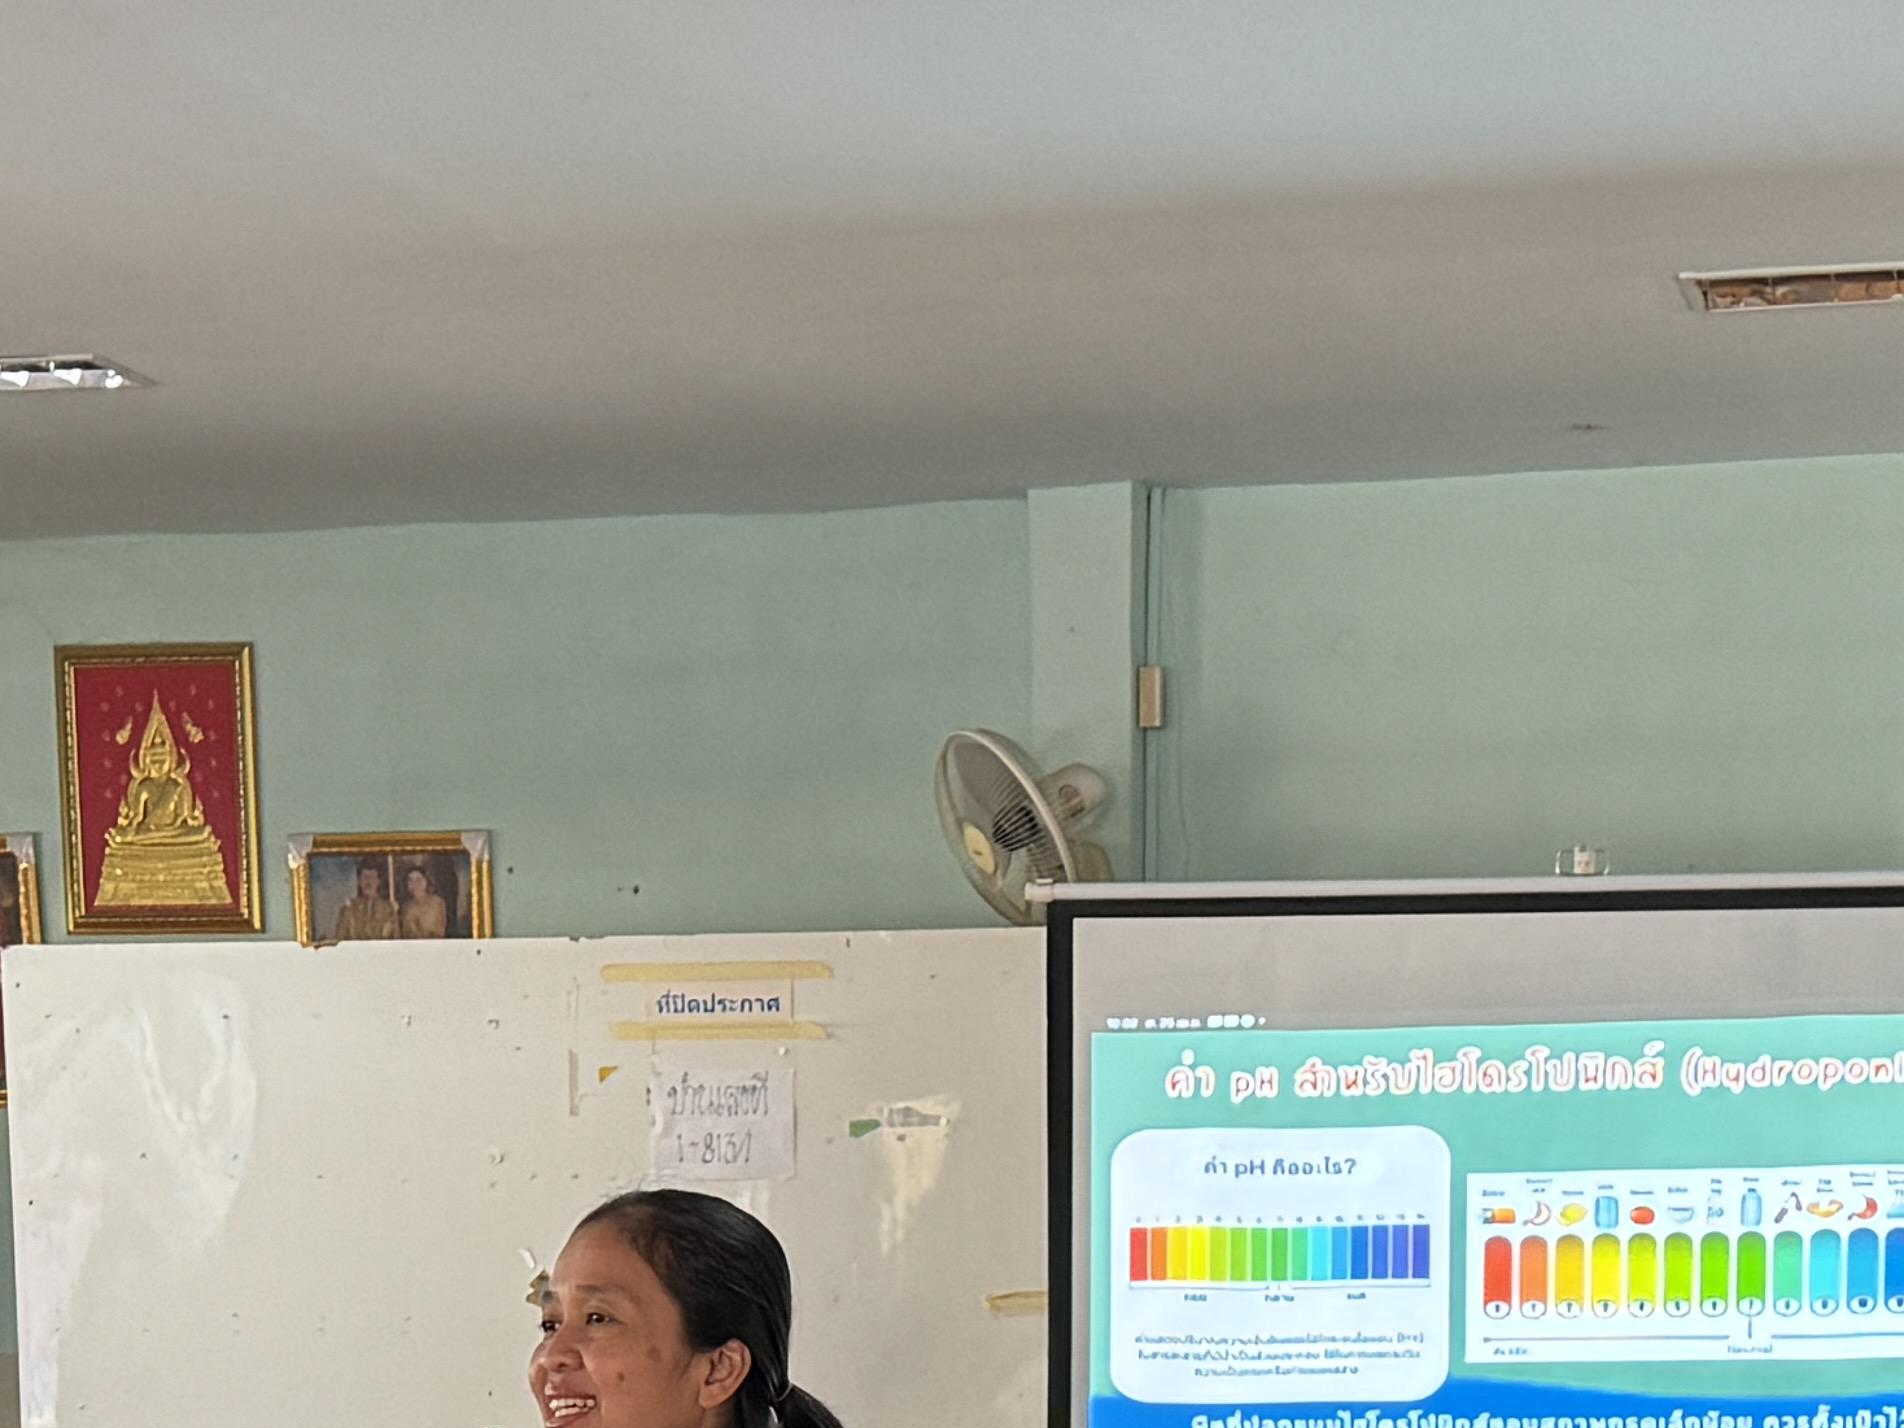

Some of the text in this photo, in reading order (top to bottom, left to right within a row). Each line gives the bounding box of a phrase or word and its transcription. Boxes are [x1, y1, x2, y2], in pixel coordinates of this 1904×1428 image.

[657, 988, 781, 1016] ที่ปิดประกาศ
[1165, 1049, 1215, 1098] ค่า
[1230, 1066, 1278, 1104] pH
[1295, 1041, 1665, 1097] สำหรับไฮโดรโปนิกส์
[1234, 1160, 1265, 1178] pH
